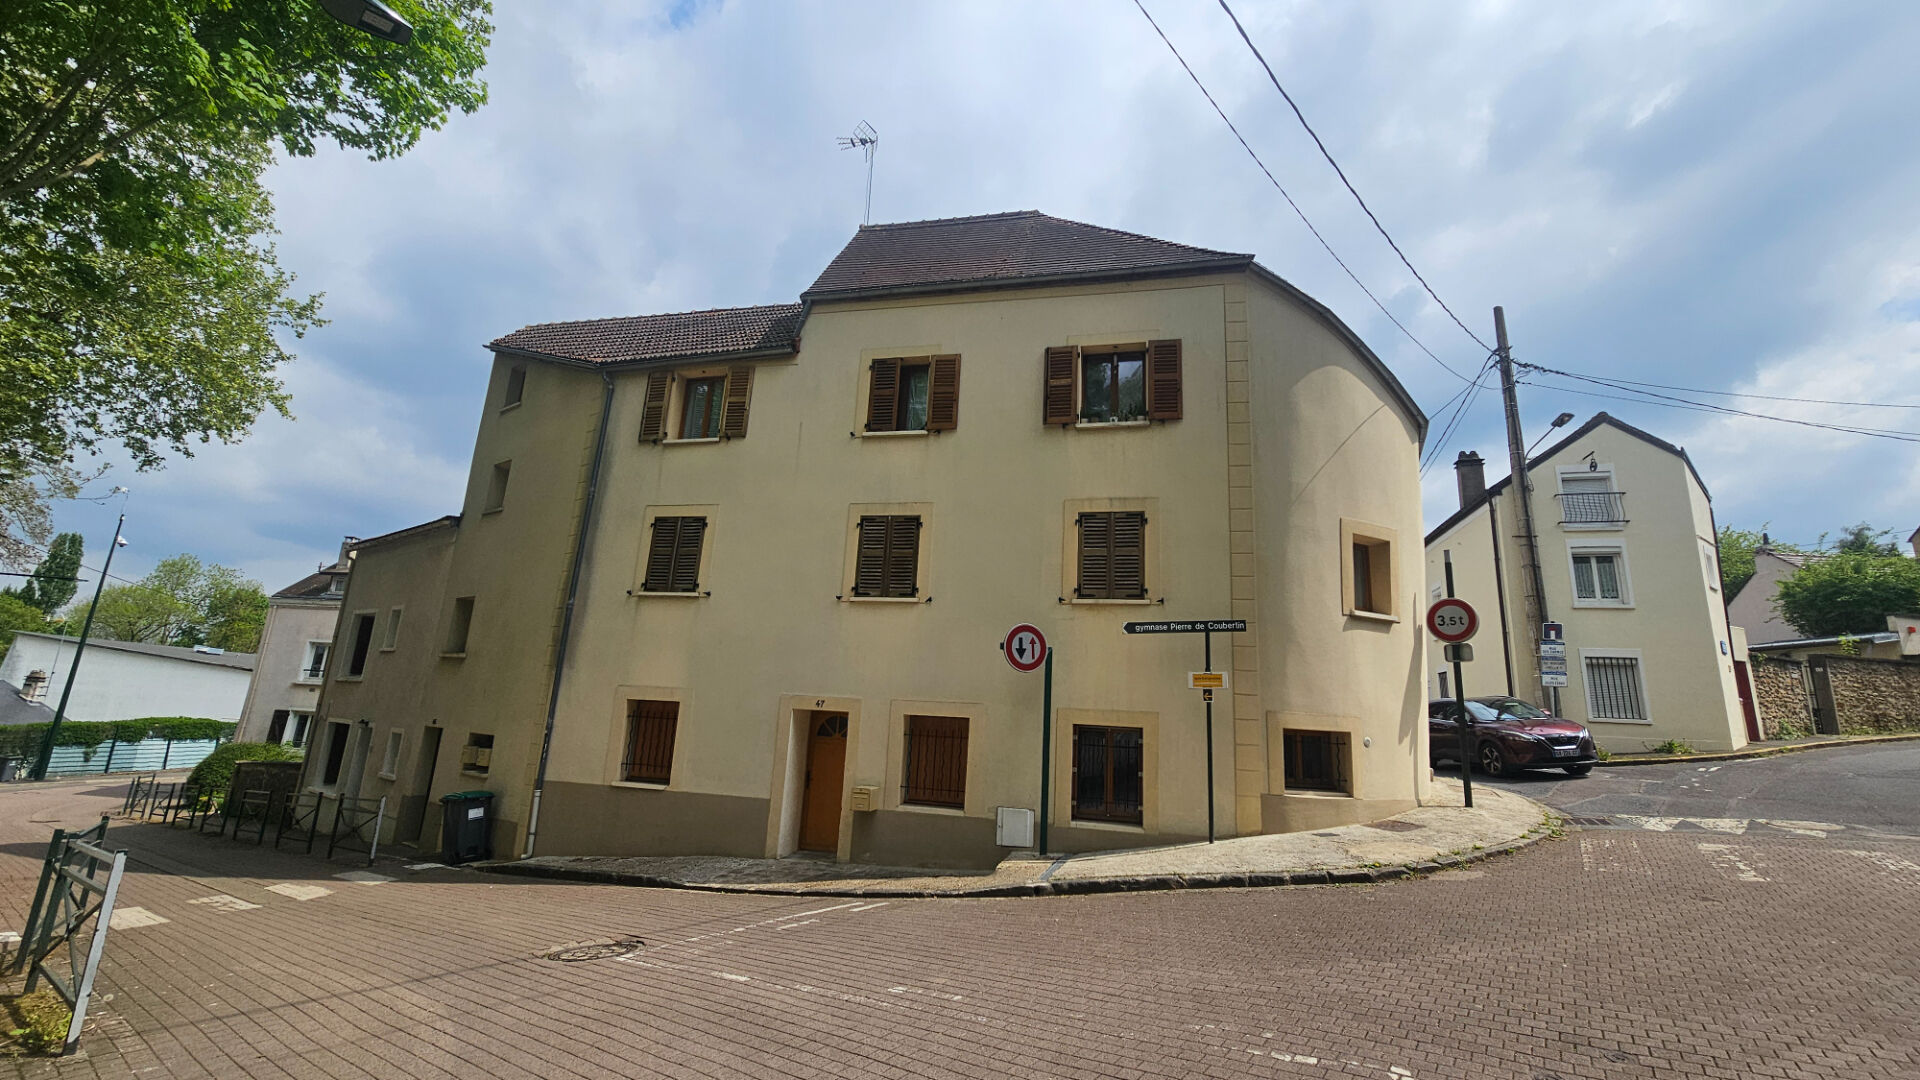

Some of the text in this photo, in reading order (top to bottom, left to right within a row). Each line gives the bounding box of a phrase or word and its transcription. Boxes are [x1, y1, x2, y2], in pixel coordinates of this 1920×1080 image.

[1135, 621, 1245, 633] gymnase Pierre de Coubertin
[815, 699, 826, 709] 47
